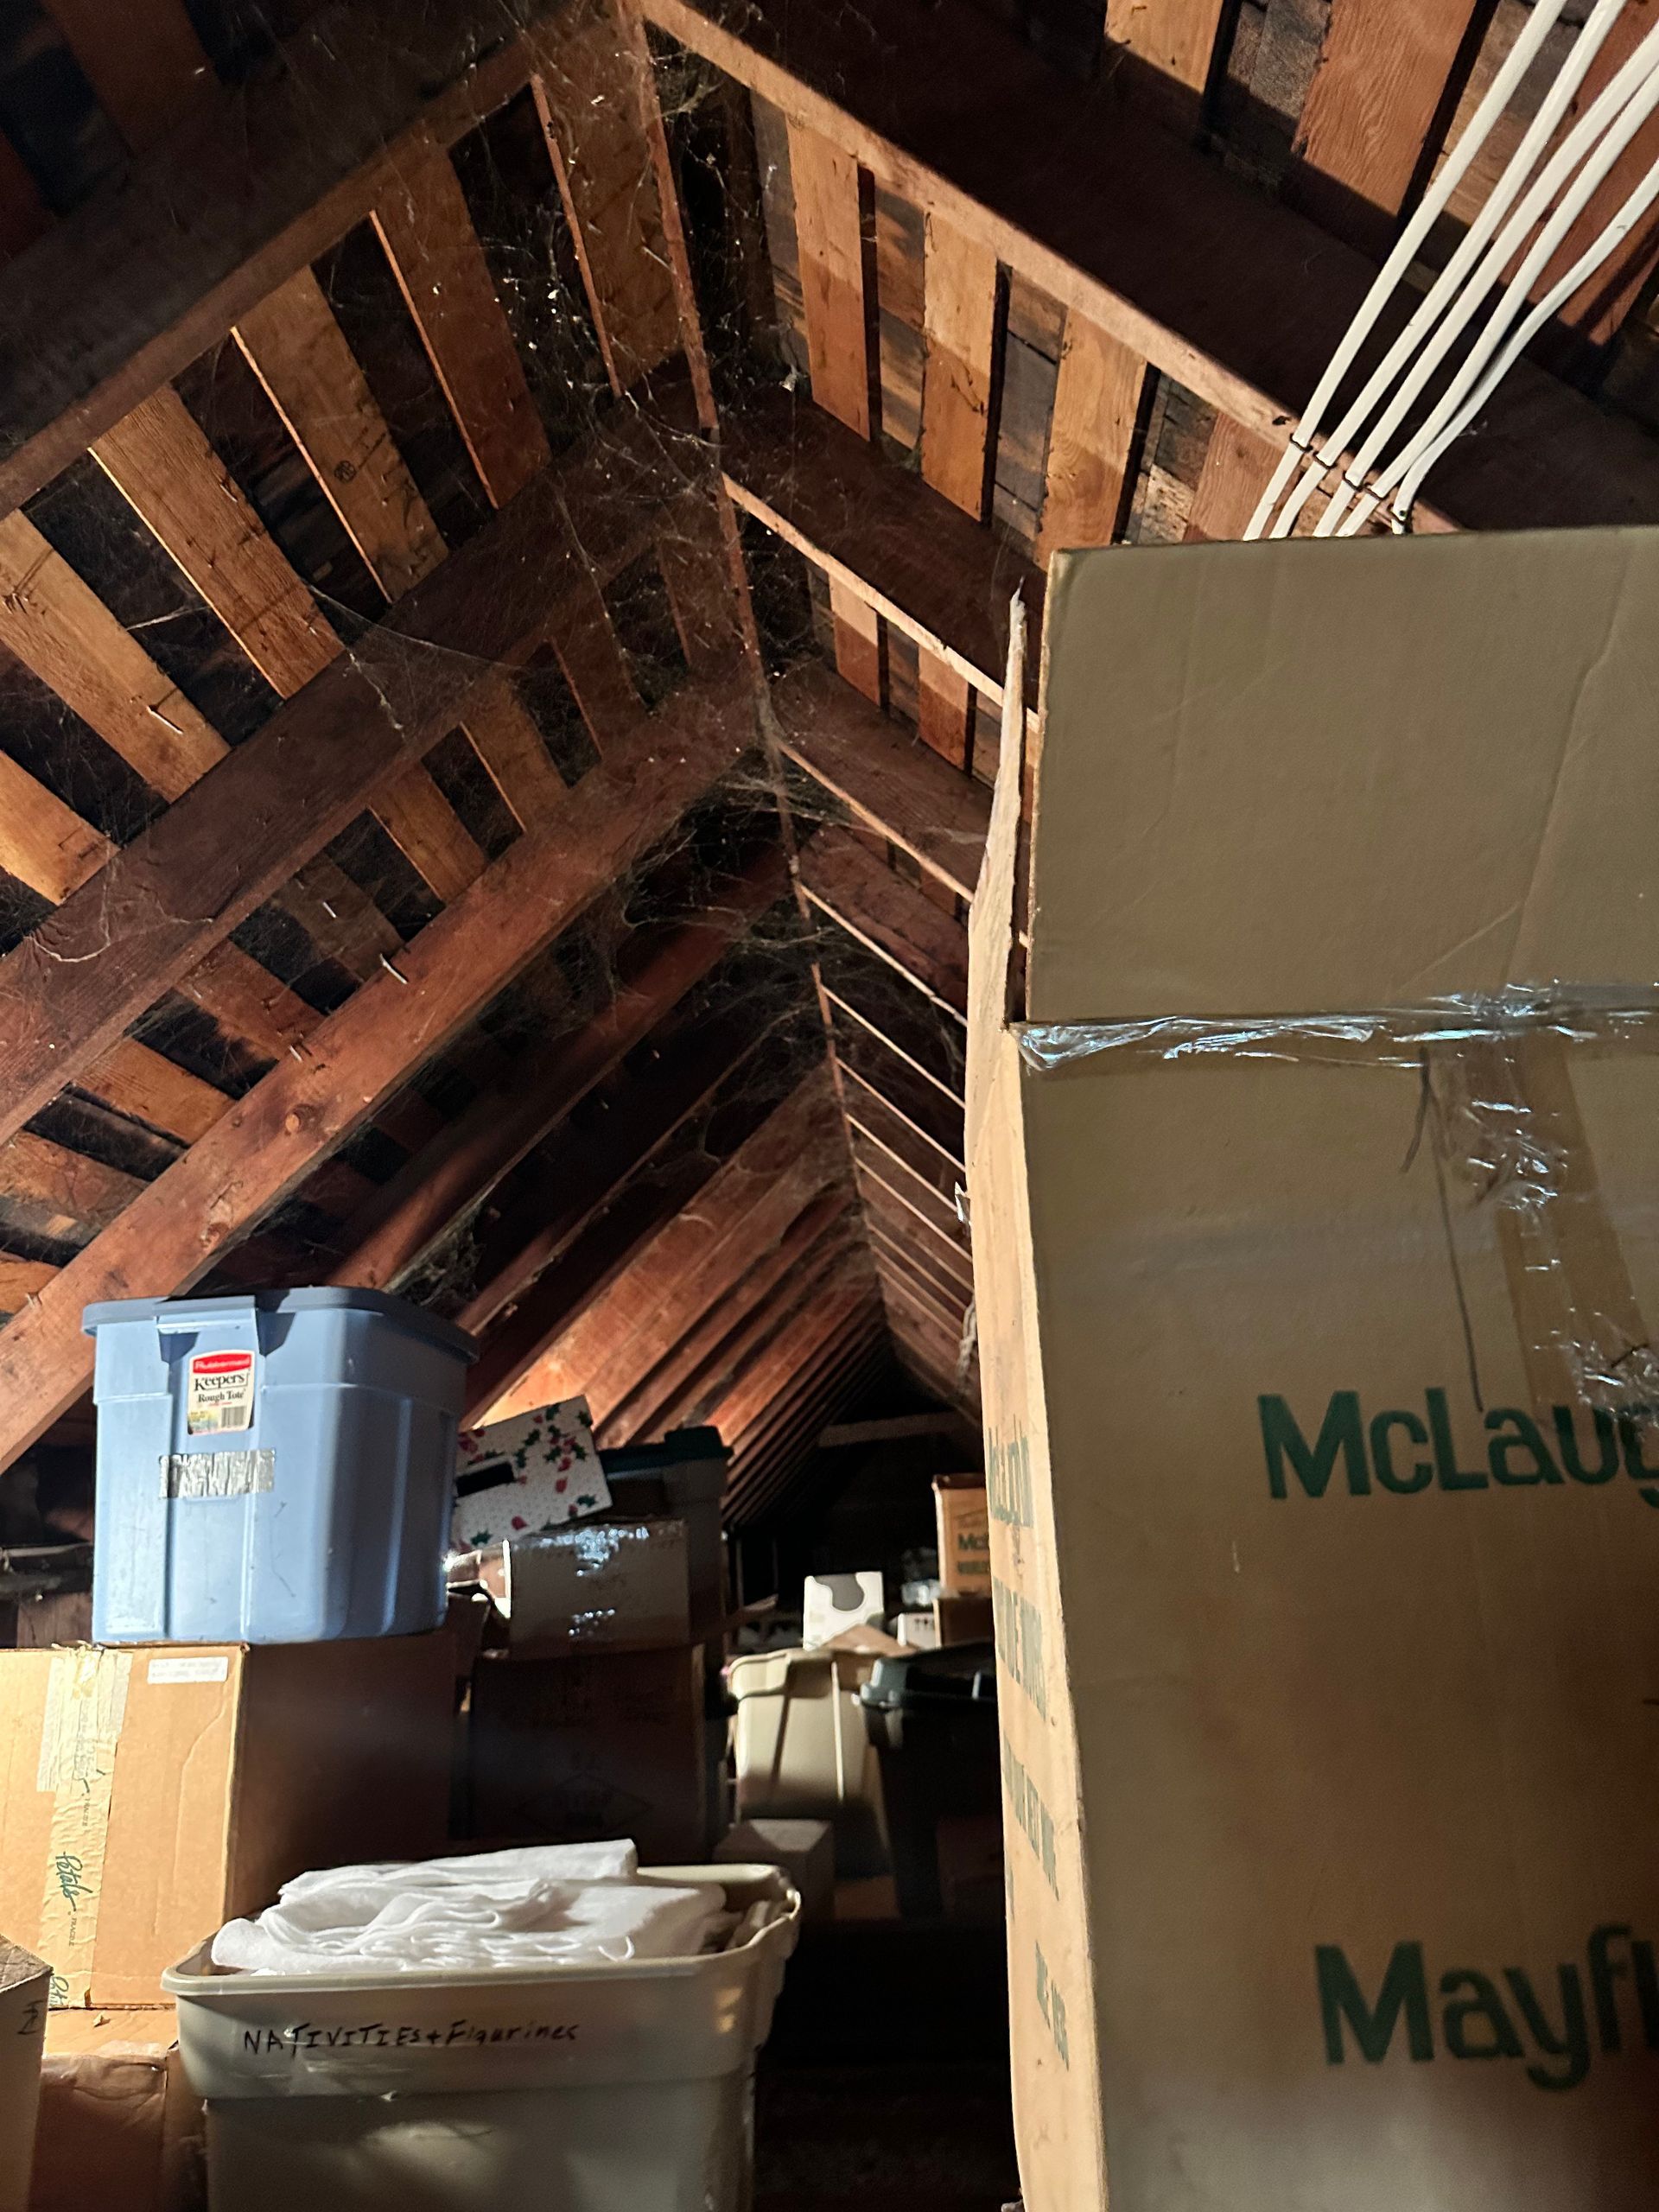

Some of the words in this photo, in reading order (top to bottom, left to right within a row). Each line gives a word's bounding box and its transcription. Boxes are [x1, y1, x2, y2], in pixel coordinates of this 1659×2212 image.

[194, 1374, 245, 1391] Keepers
[198, 1392, 225, 1403] Rough
[226, 1390, 244, 1400] Tote
